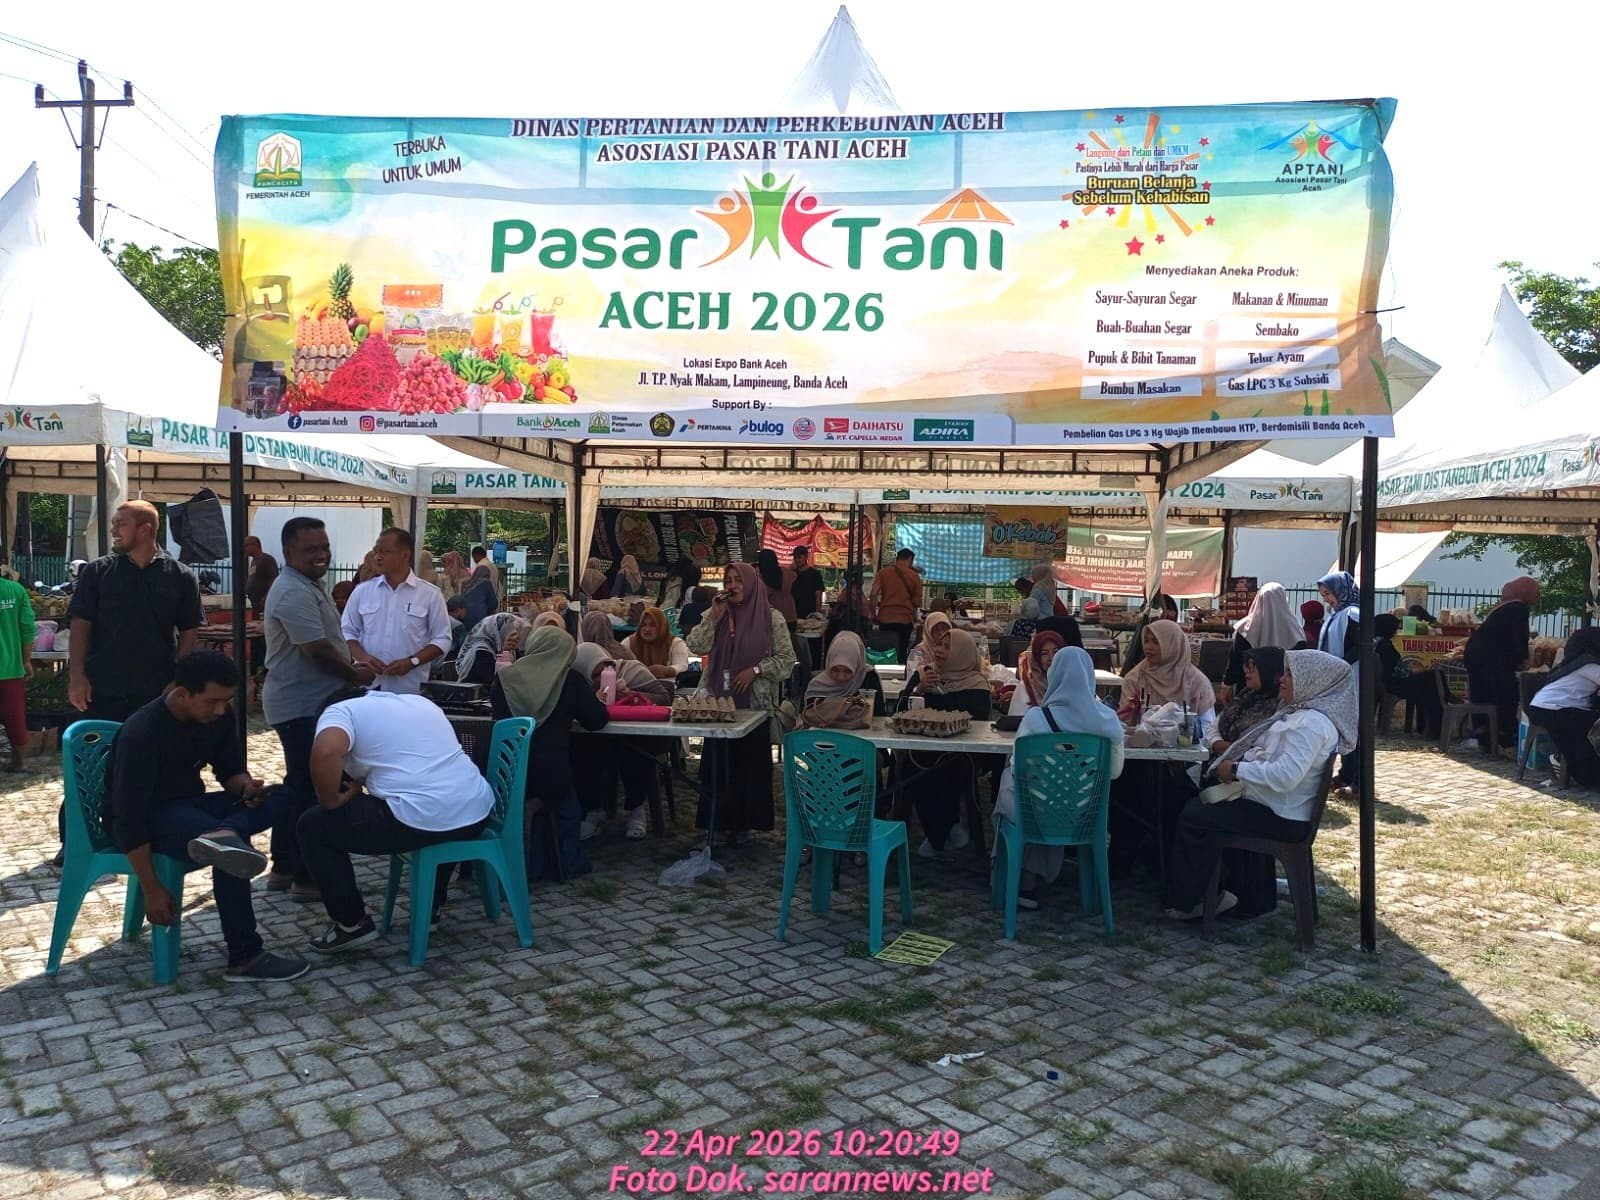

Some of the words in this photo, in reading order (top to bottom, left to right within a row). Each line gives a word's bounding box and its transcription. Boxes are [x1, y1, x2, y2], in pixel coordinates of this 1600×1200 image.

[512, 119, 579, 138] DINAS
[583, 118, 715, 137] PERTANIAN
[723, 117, 767, 135] DAN
[774, 114, 935, 134] PERKEBUNAN
[942, 111, 1006, 131] ACEH
[393, 135, 447, 159] TERBUKA
[597, 142, 699, 162] ASOSIASI
[707, 141, 778, 161] PASAR
[786, 139, 843, 160] TANI
[847, 138, 908, 159] ACEH
[1117, 147, 1131, 157] dari
[1132, 146, 1153, 157] Petani
[1154, 146, 1165, 156] dan
[1167, 145, 1189, 156] UMKM
[382, 163, 422, 184] UNTUK
[426, 157, 462, 178] UMUM
[1076, 162, 1103, 174] Pastinya
[1104, 162, 1122, 173] Lebih
[1123, 162, 1143, 173] Murah
[1145, 161, 1158, 172] dari
[1160, 161, 1179, 173] Harga
[1180, 160, 1199, 172] Pasar
[1283, 163, 1344, 176] APTANI
[1087, 176, 1140, 190] Buruan
[1142, 175, 1197, 192] Belanja
[1275, 177, 1308, 185] Asosiasi
[1310, 176, 1332, 185] Pasar
[1333, 176, 1347, 186] Tani
[1303, 184, 1322, 192] Aceh
[246, 191, 289, 199] PEMERINTAH
[290, 190, 310, 198] ACEH
[1073, 190, 1132, 205] Sebelum
[1135, 188, 1210, 205] Kehabisan
[492, 219, 698, 272] Pasar
[831, 217, 1004, 272] Tani
[1146, 265, 1217, 278] Menyediakan
[1220, 265, 1253, 277] Aneka
[1256, 266, 1300, 278] Produk:
[1095, 291, 1166, 306] Sayur-Sayuran
[1168, 292, 1197, 307] Segar
[1232, 292, 1273, 307] Makanan
[1276, 293, 1284, 306] &
[1286, 292, 1329, 307] Minuman
[598, 291, 731, 330] ACEH
[750, 292, 885, 332] 2026
[1096, 319, 1162, 334] Buah-Buahan
[1164, 321, 1193, 336] Segar
[1256, 323, 1299, 337] Sembako
[683, 357, 713, 370] Lokasi
[715, 358, 738, 372] Expo
[740, 358, 763, 370] Bank
[764, 358, 788, 370] Aceh
[1088, 351, 1119, 366] Pupuk
[1120, 351, 1129, 364] &
[1131, 351, 1154, 365] Bibit
[1155, 352, 1197, 366] Tanaman
[1248, 352, 1273, 365] Telur
[1276, 351, 1305, 365] Ayam
[638, 372, 650, 387] Jl.
[652, 373, 668, 386] T.P.
[670, 373, 693, 388] Nyak
[695, 373, 731, 388] Makam,
[733, 374, 791, 390] Lampineung,
[794, 374, 823, 389] Banda
[825, 375, 848, 390] Aceh
[1100, 381, 1135, 396] Bumbu
[1137, 382, 1182, 396] Masakan
[1228, 378, 1245, 391] Gas
[1246, 377, 1267, 391] LPG
[1268, 378, 1277, 389] 3
[1279, 376, 1292, 390] Kg
[1294, 373, 1330, 387] Subsidi
[711, 398, 751, 411] Support
[753, 399, 767, 411] By
[33, 416, 64, 431] Tani
[332, 416, 348, 428] Aceh
[516, 416, 542, 427] Bank
[554, 416, 581, 428] Aceh
[697, 424, 732, 432] PERTAMINA
[749, 420, 784, 436] bulog
[853, 420, 904, 432] DAIHATSU
[920, 427, 969, 436] ADIRA
[1063, 428, 1107, 440] Pembelian
[1108, 428, 1124, 439] Gas
[1125, 428, 1142, 439] LPG
[1143, 429, 1150, 438] 3
[1151, 428, 1163, 440] Kg
[1164, 426, 1189, 439] Wajib
[1192, 425, 1237, 437] Membawa
[1239, 423, 1260, 435] KTP,
[1262, 422, 1311, 433] Berdomisili
[1313, 421, 1340, 432] Banda
[1342, 420, 1365, 431] Aceh
[162, 418, 210, 447] PASAR
[312, 446, 338, 470] ACEH
[340, 455, 364, 476] 2024
[465, 473, 517, 489] PASAR
[522, 473, 557, 489] TANI
[1376, 477, 1401, 497] PASAR
[1402, 472, 1423, 495] TANI
[1423, 465, 1481, 490] DISTANBUN
[1482, 459, 1512, 481] ACEH
[1514, 452, 1548, 478] 2024
[1179, 482, 1226, 499] 2024
[1250, 488, 1277, 502] Pasar
[1301, 489, 1323, 501] Tani
[1402, 639, 1423, 652] TAHU
